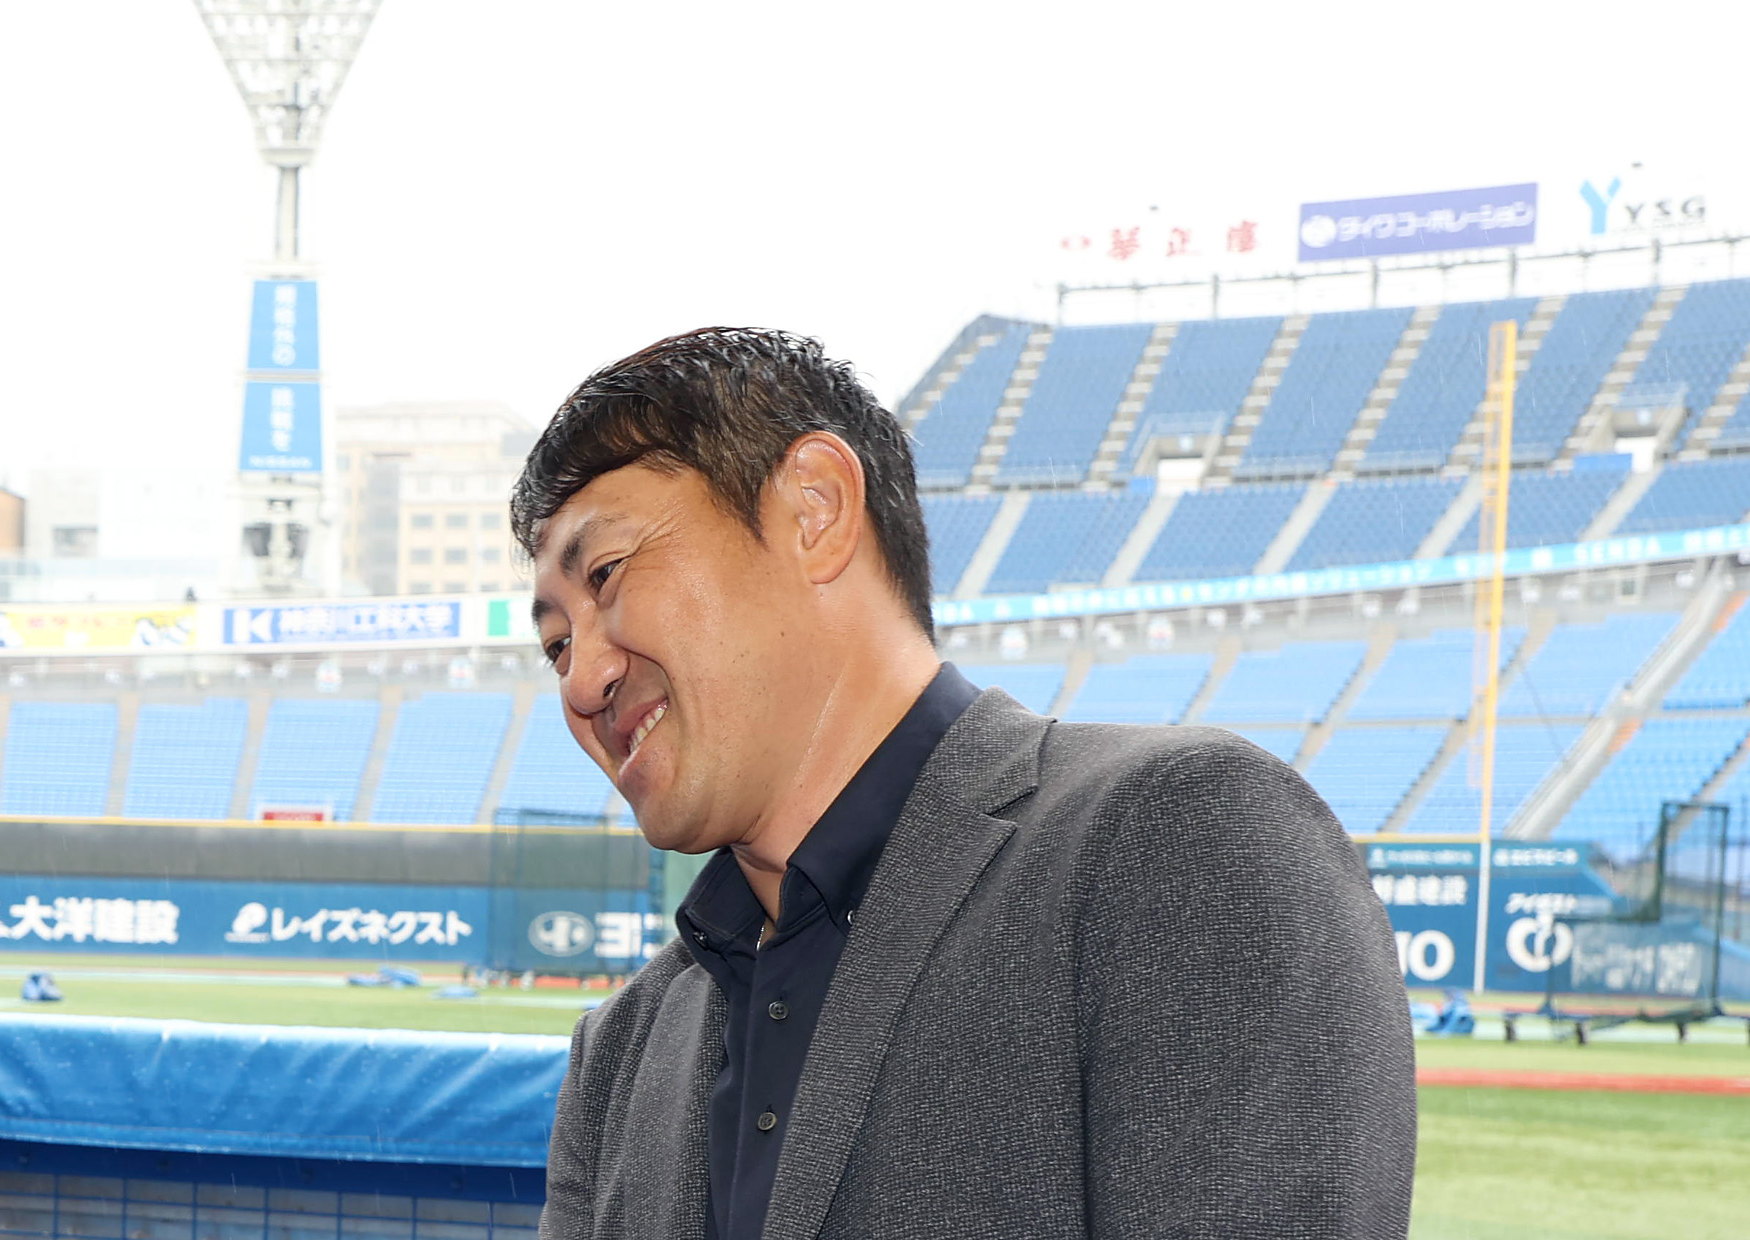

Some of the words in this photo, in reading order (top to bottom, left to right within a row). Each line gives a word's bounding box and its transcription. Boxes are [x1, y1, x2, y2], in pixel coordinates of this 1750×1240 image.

[1623, 195, 1707, 223] YSG
[9, 894, 180, 944] 大洋建設
[270, 906, 472, 945] レイズネクスト
